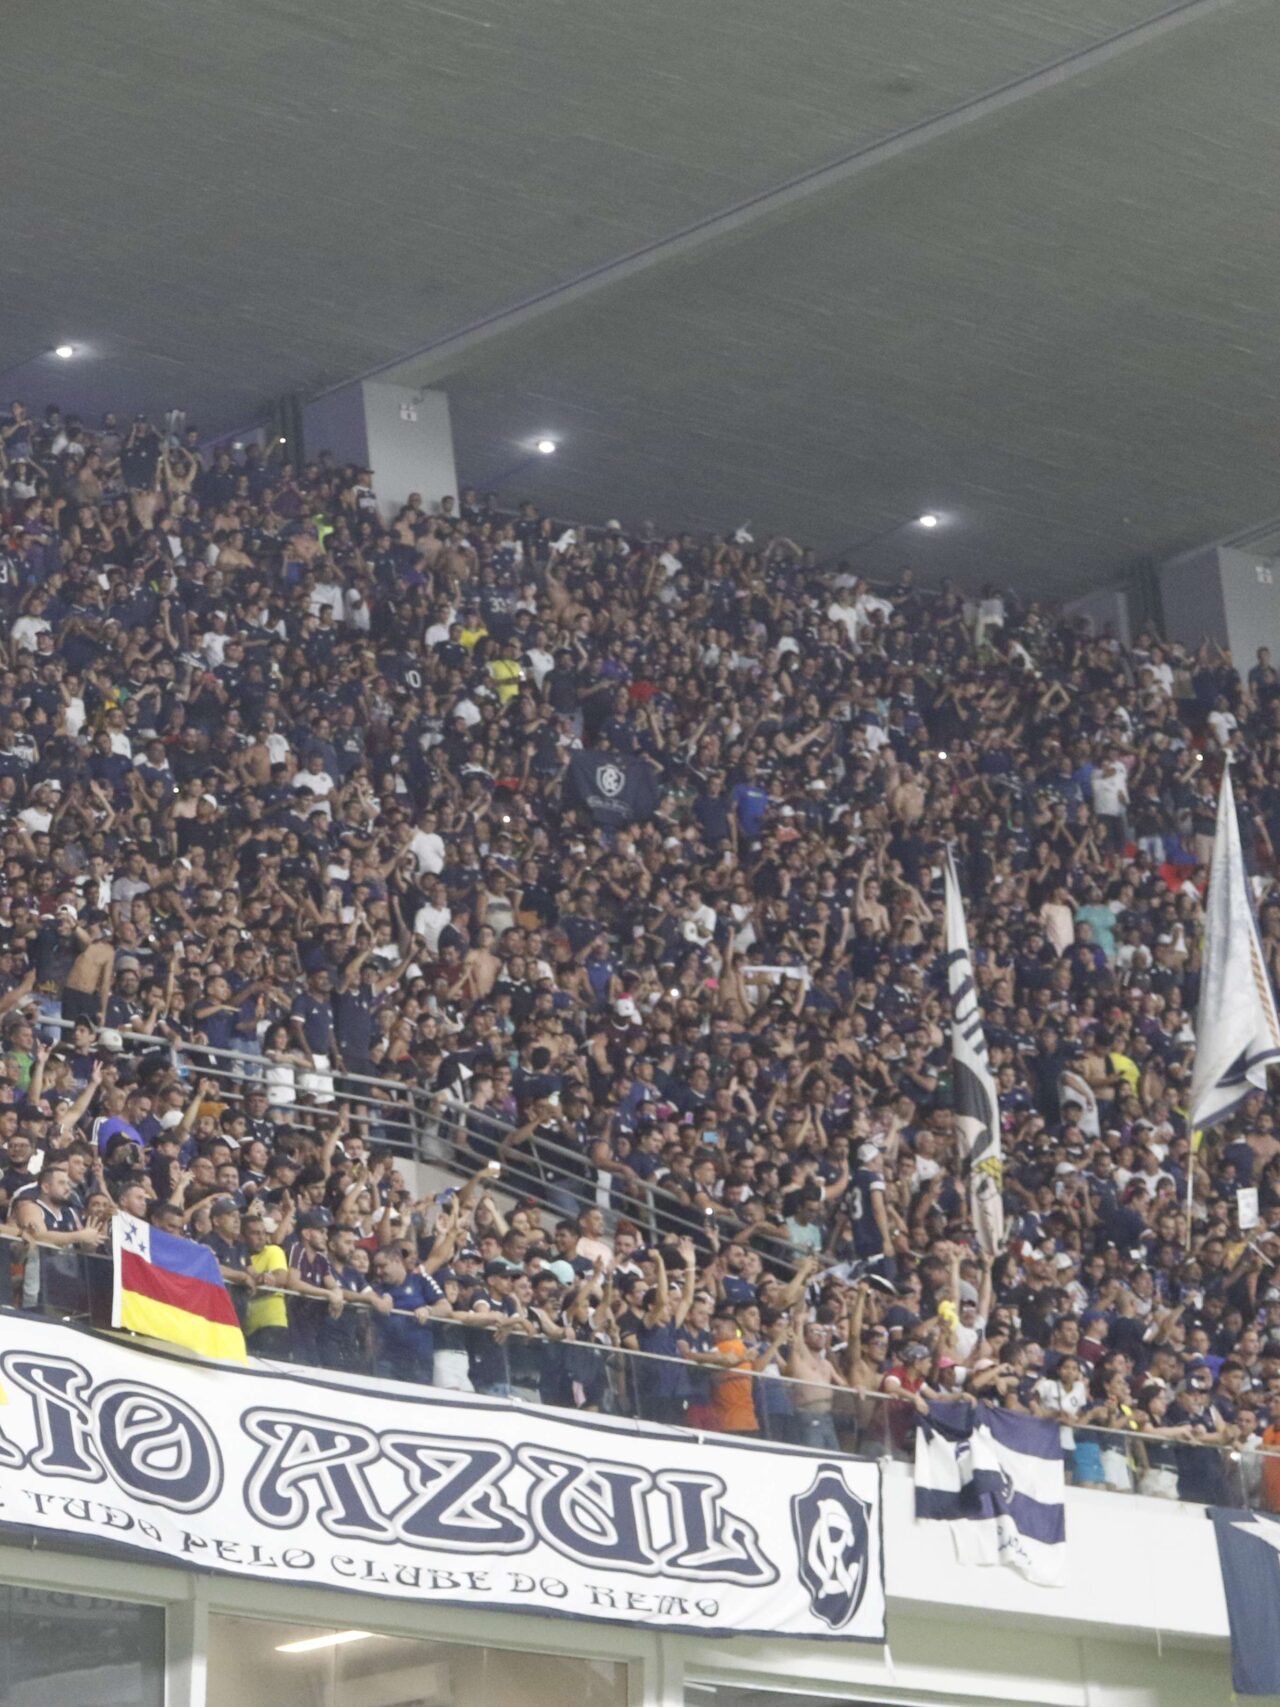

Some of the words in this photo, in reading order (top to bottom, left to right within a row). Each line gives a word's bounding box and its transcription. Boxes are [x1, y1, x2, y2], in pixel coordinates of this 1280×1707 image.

[21, 1489, 163, 1543] TUDO
[180, 1529, 316, 1570] PELO
[329, 1555, 492, 1592] CLUBE
[507, 1571, 570, 1599] DO
[584, 1583, 720, 1619] REMO
[240, 1406, 780, 1587] AZUL
